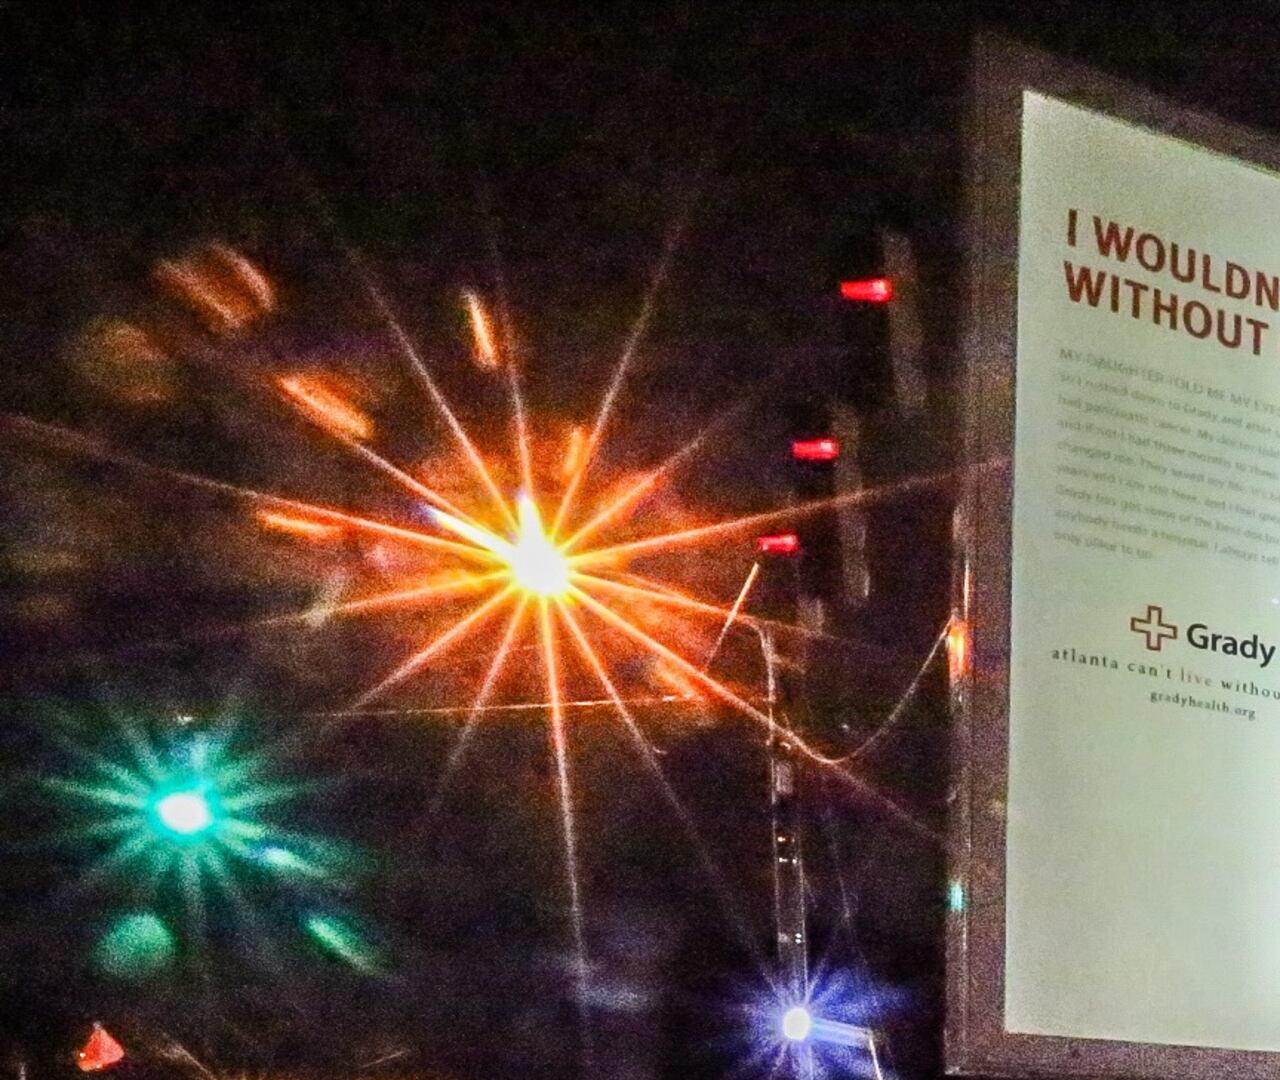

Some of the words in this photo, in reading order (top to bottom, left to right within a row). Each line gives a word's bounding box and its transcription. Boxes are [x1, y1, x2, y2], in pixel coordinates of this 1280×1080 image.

[1067, 209, 1078, 247] I
[1063, 260, 1269, 356] WITHOUT
[1186, 624, 1276, 668] Grady
[1052, 648, 1119, 670] atlanta
[1127, 661, 1173, 681] can't
[1181, 667, 1213, 688] live
[1150, 690, 1257, 721] gradyhealth.org
